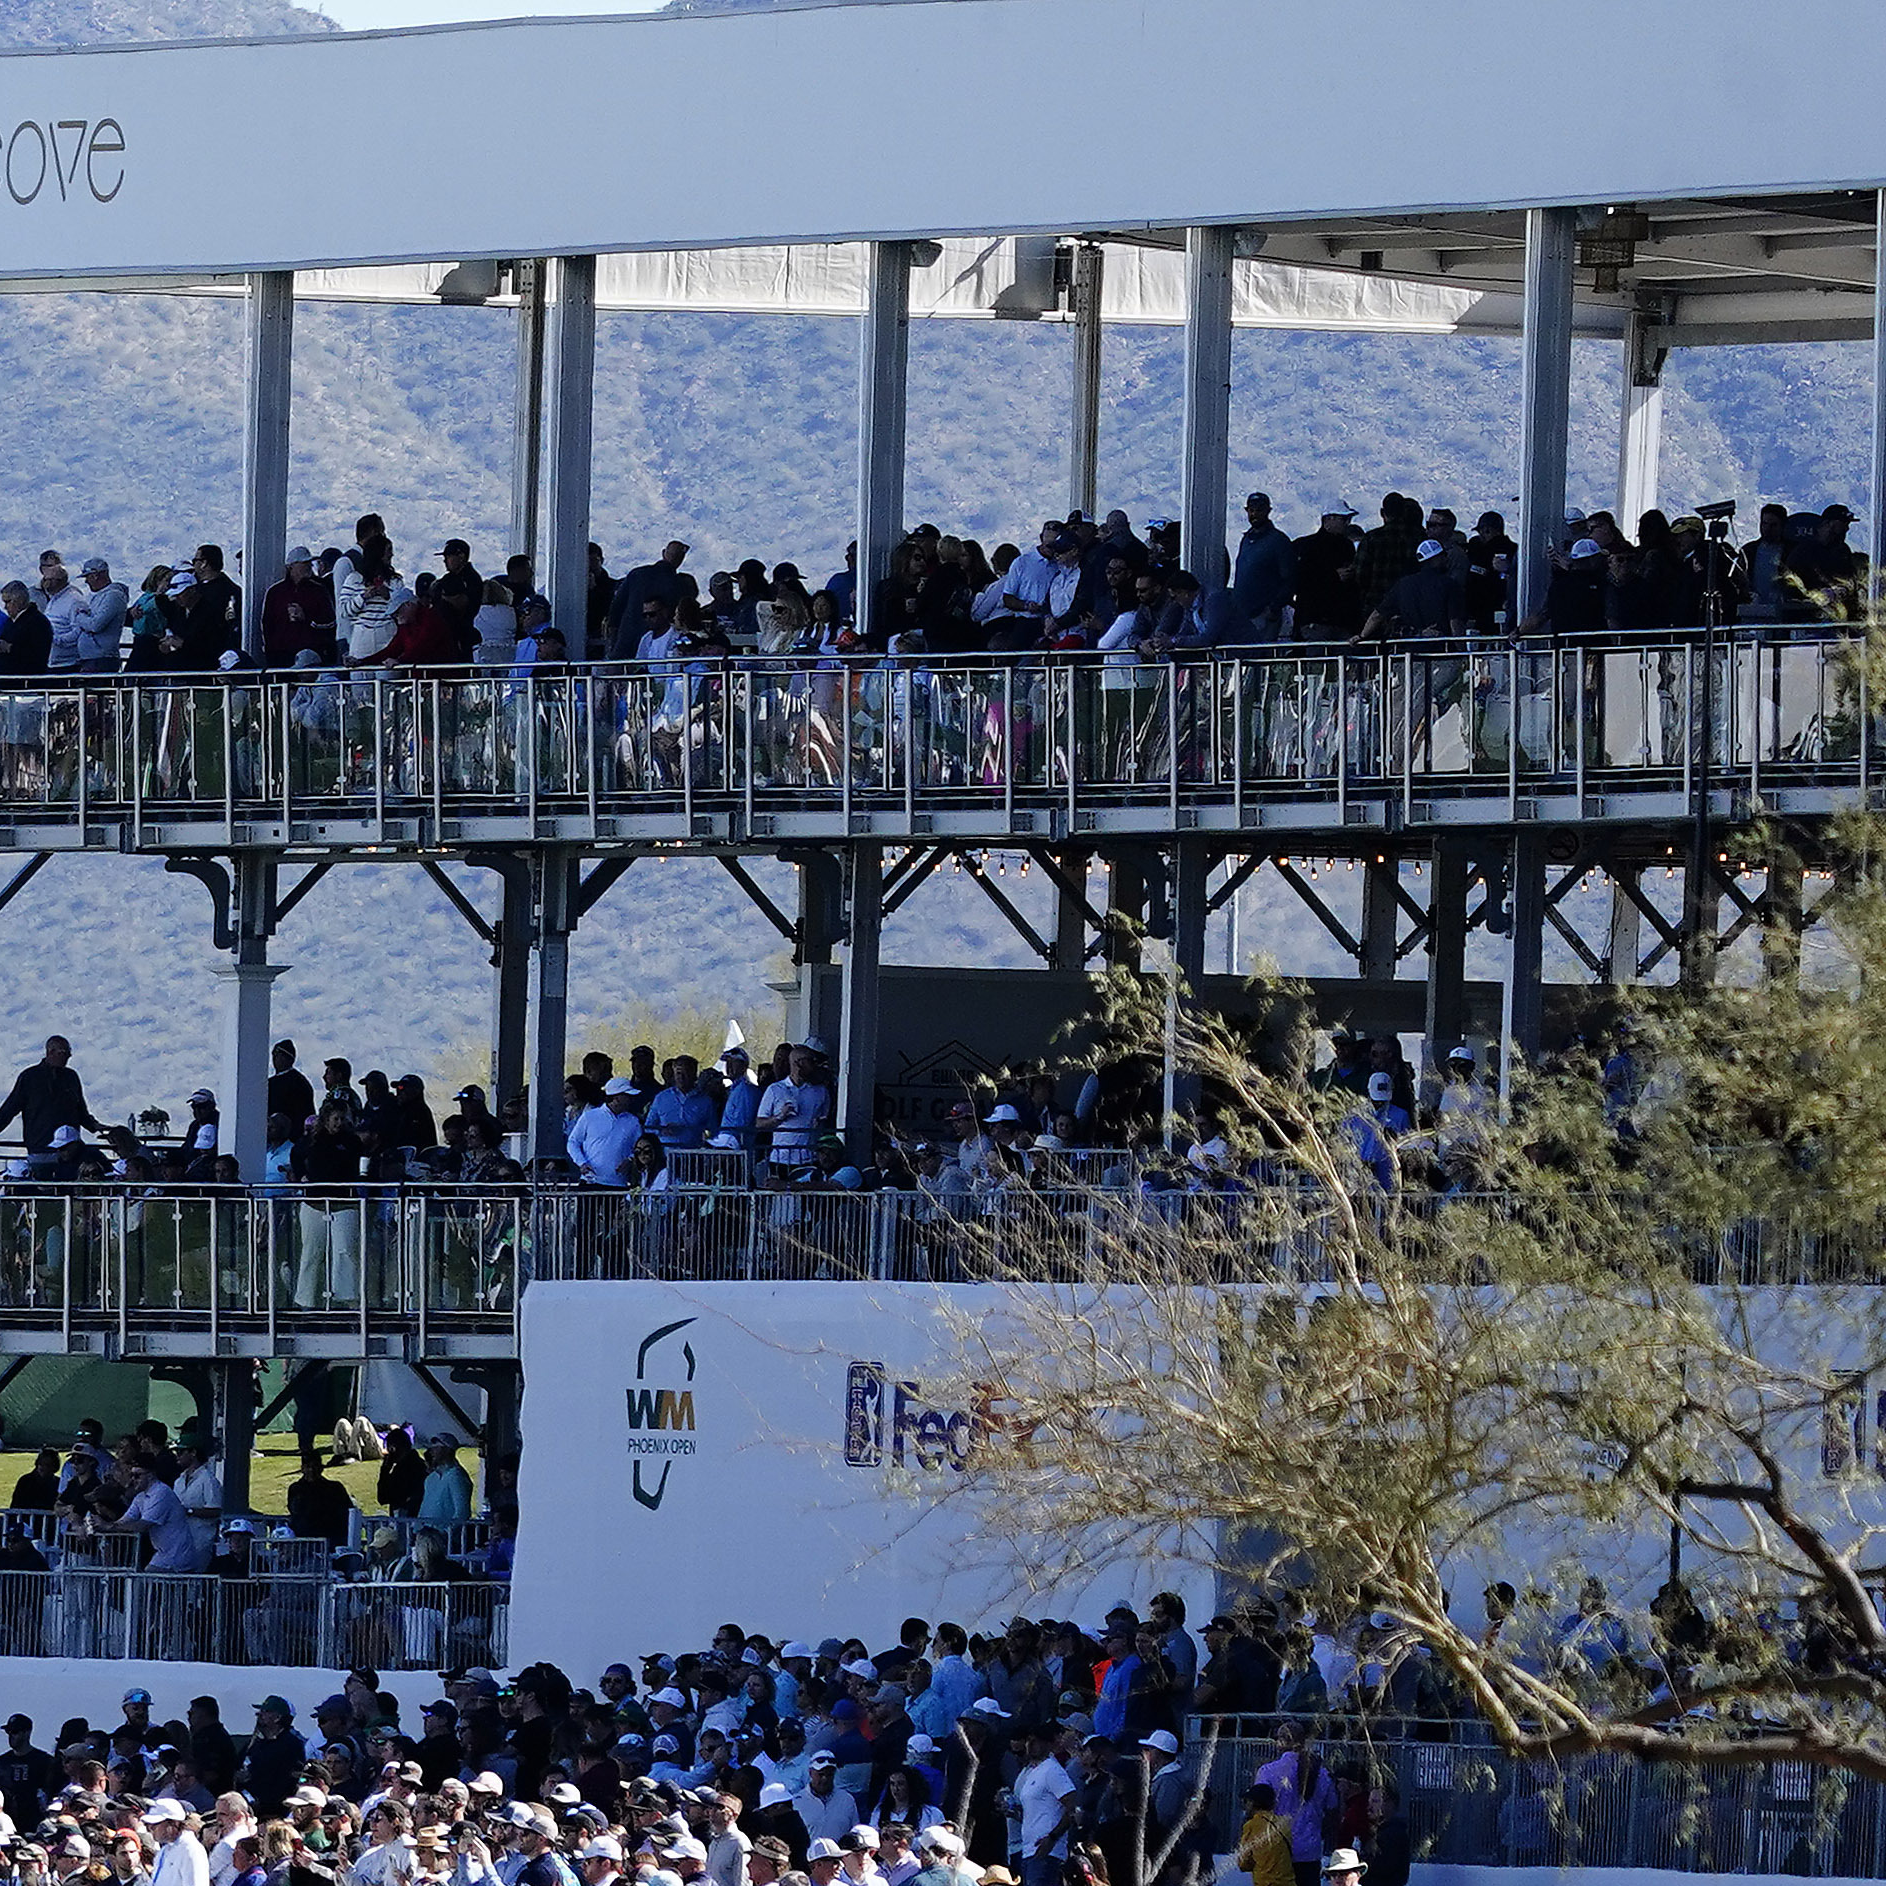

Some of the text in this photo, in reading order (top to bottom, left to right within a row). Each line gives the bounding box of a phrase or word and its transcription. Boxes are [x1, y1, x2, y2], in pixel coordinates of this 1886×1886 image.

[626, 1389, 696, 1431] WM
[627, 1437, 697, 1456] PHOENIX OPEN
